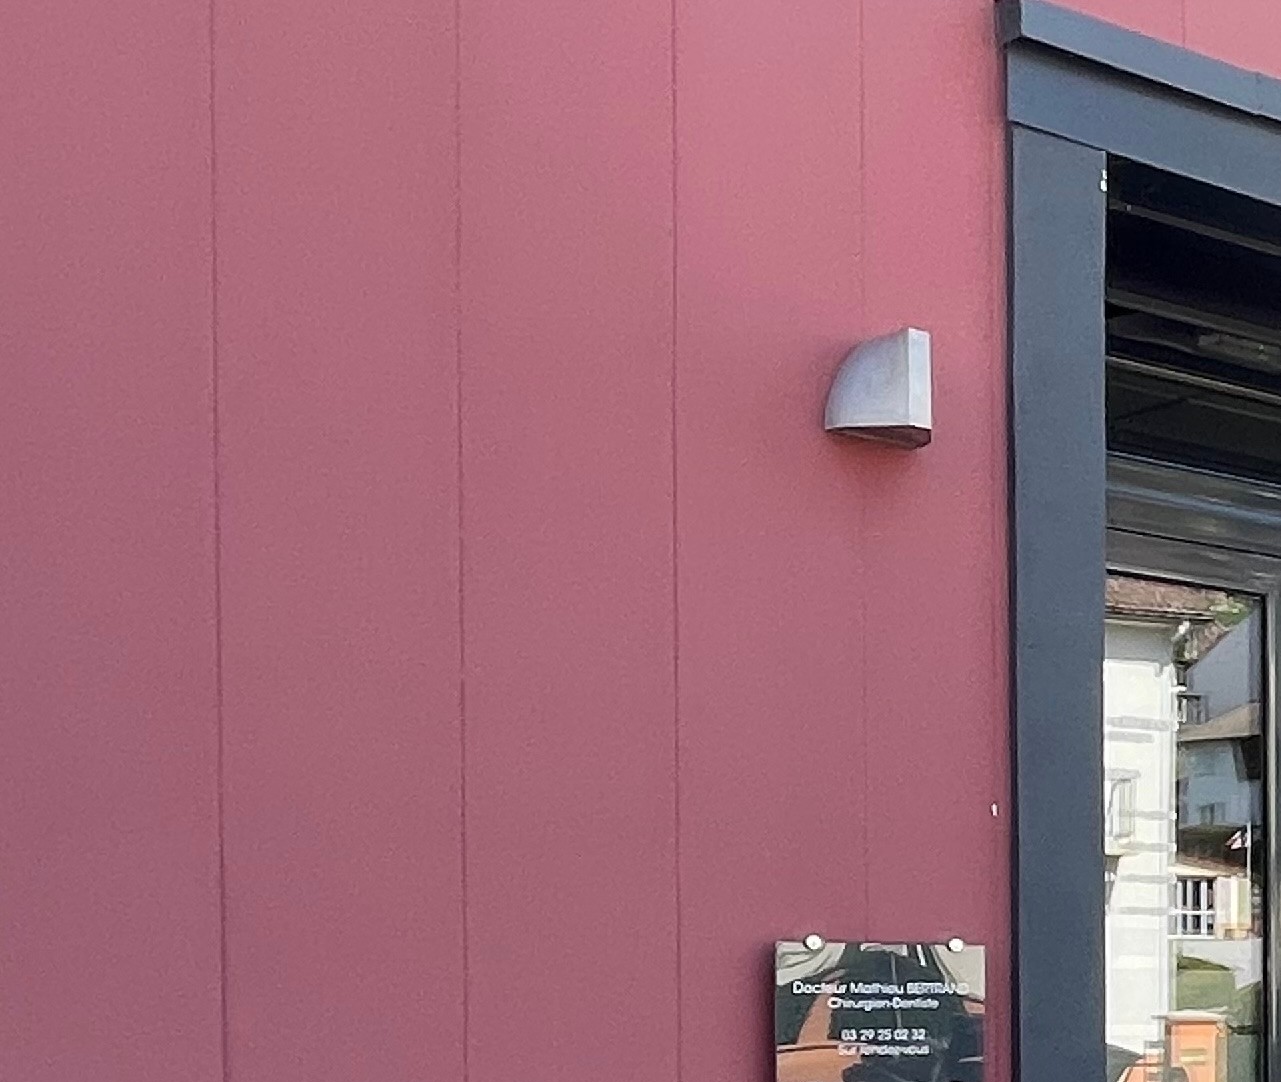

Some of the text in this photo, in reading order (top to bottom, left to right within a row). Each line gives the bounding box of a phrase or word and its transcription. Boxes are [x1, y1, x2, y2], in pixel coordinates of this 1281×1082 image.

[793, 981, 847, 994] Docteur
[850, 982, 904, 994] Mathieu
[841, 1028, 857, 1041] 03
[859, 1028, 875, 1041] 29
[877, 1028, 892, 1041] 25
